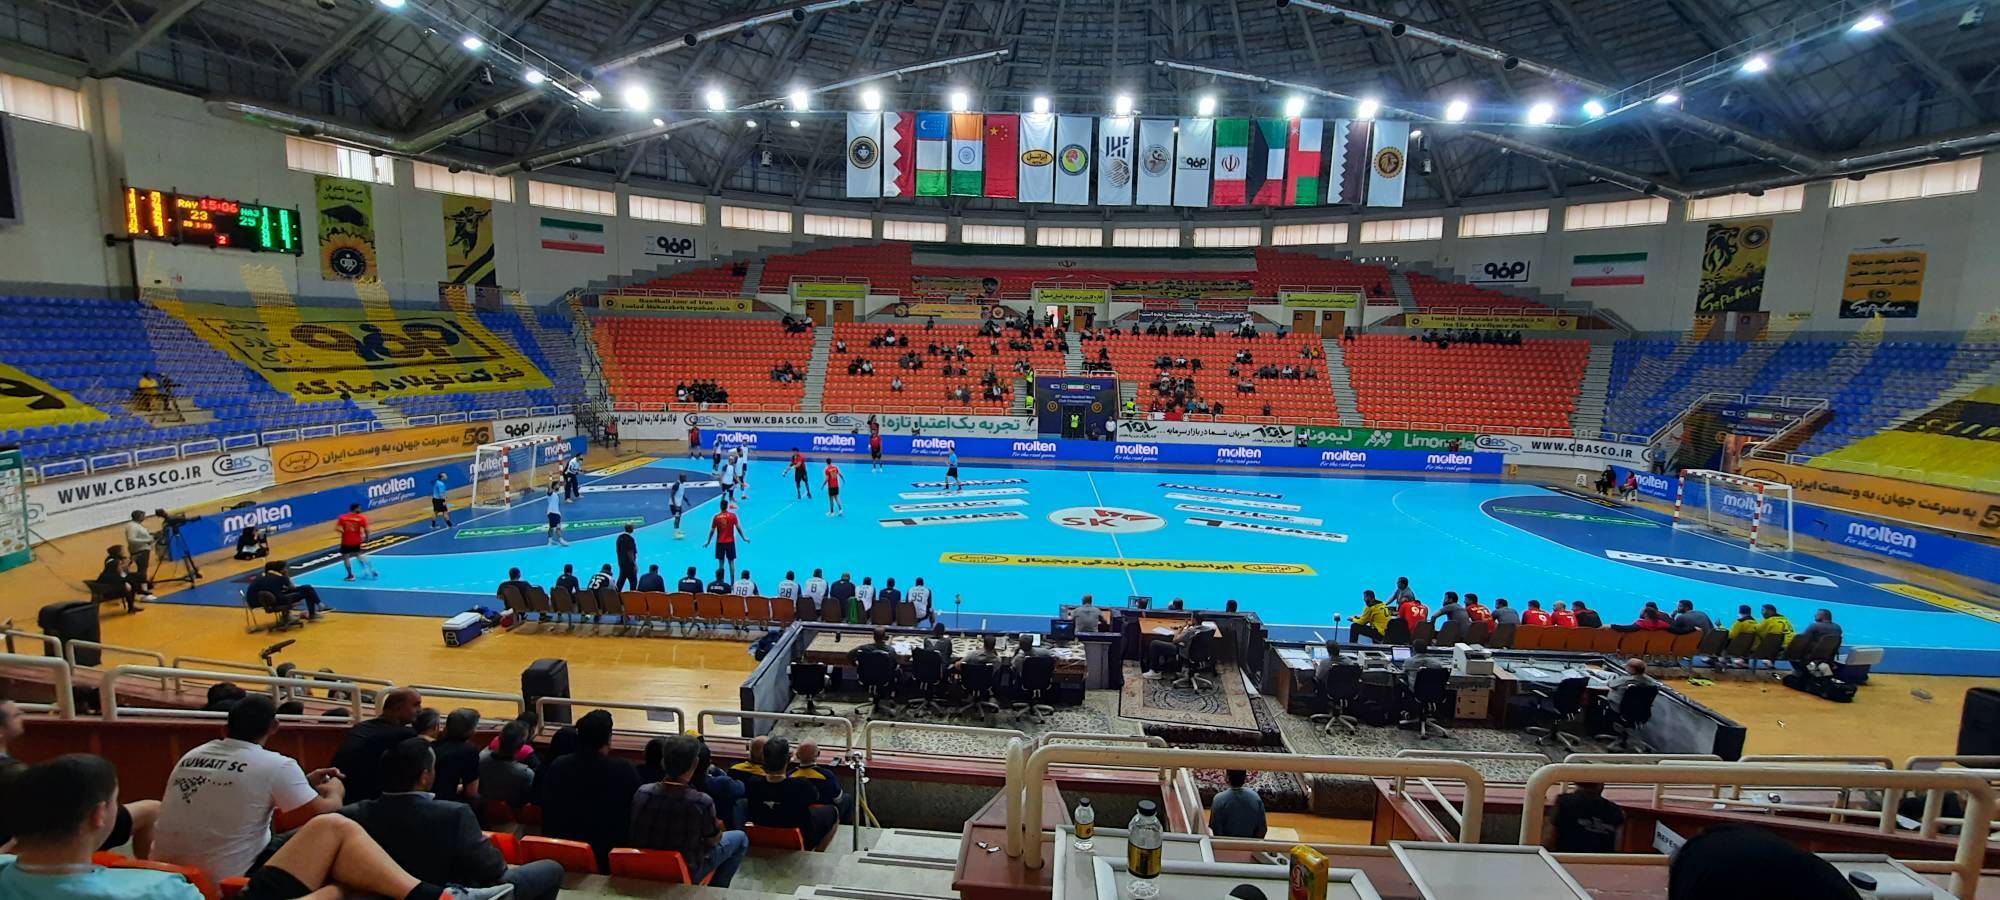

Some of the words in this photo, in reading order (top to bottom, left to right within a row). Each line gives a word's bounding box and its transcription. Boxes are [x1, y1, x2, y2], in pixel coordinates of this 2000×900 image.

[178, 199, 198, 209] RAY
[201, 200, 238, 213] 15:06
[191, 210, 208, 221] 23
[240, 216, 256, 227] 25
[734, 416, 818, 425] WWW.CBASCO.IR
[912, 416, 952, 431] اعتبا
[979, 418, 1020, 434] تجربه
[463, 426, 490, 446] 5G
[814, 435, 856, 446] molten
[912, 438, 955, 449] molten
[1305, 429, 1352, 445] لیمونا
[1404, 433, 1475, 450] Limonde
[1014, 442, 1057, 452] molten
[1115, 444, 1159, 455] molten
[1218, 448, 1262, 458] molten
[1531, 441, 1633, 459] WWW.CBASCO.IR
[1322, 450, 1367, 462] molten
[1428, 454, 1473, 465] molten
[58, 466, 201, 504] WWW.CBASCO.IR
[368, 476, 415, 498] molten
[224, 504, 292, 532] molten
[922, 512, 1020, 522] ALKASS
[1062, 516, 1117, 528] SK
[1231, 522, 1342, 539] ALKASS
[1848, 522, 1917, 549] molten
[180, 757, 226, 769] KUWAIT
[228, 762, 248, 773] SC
